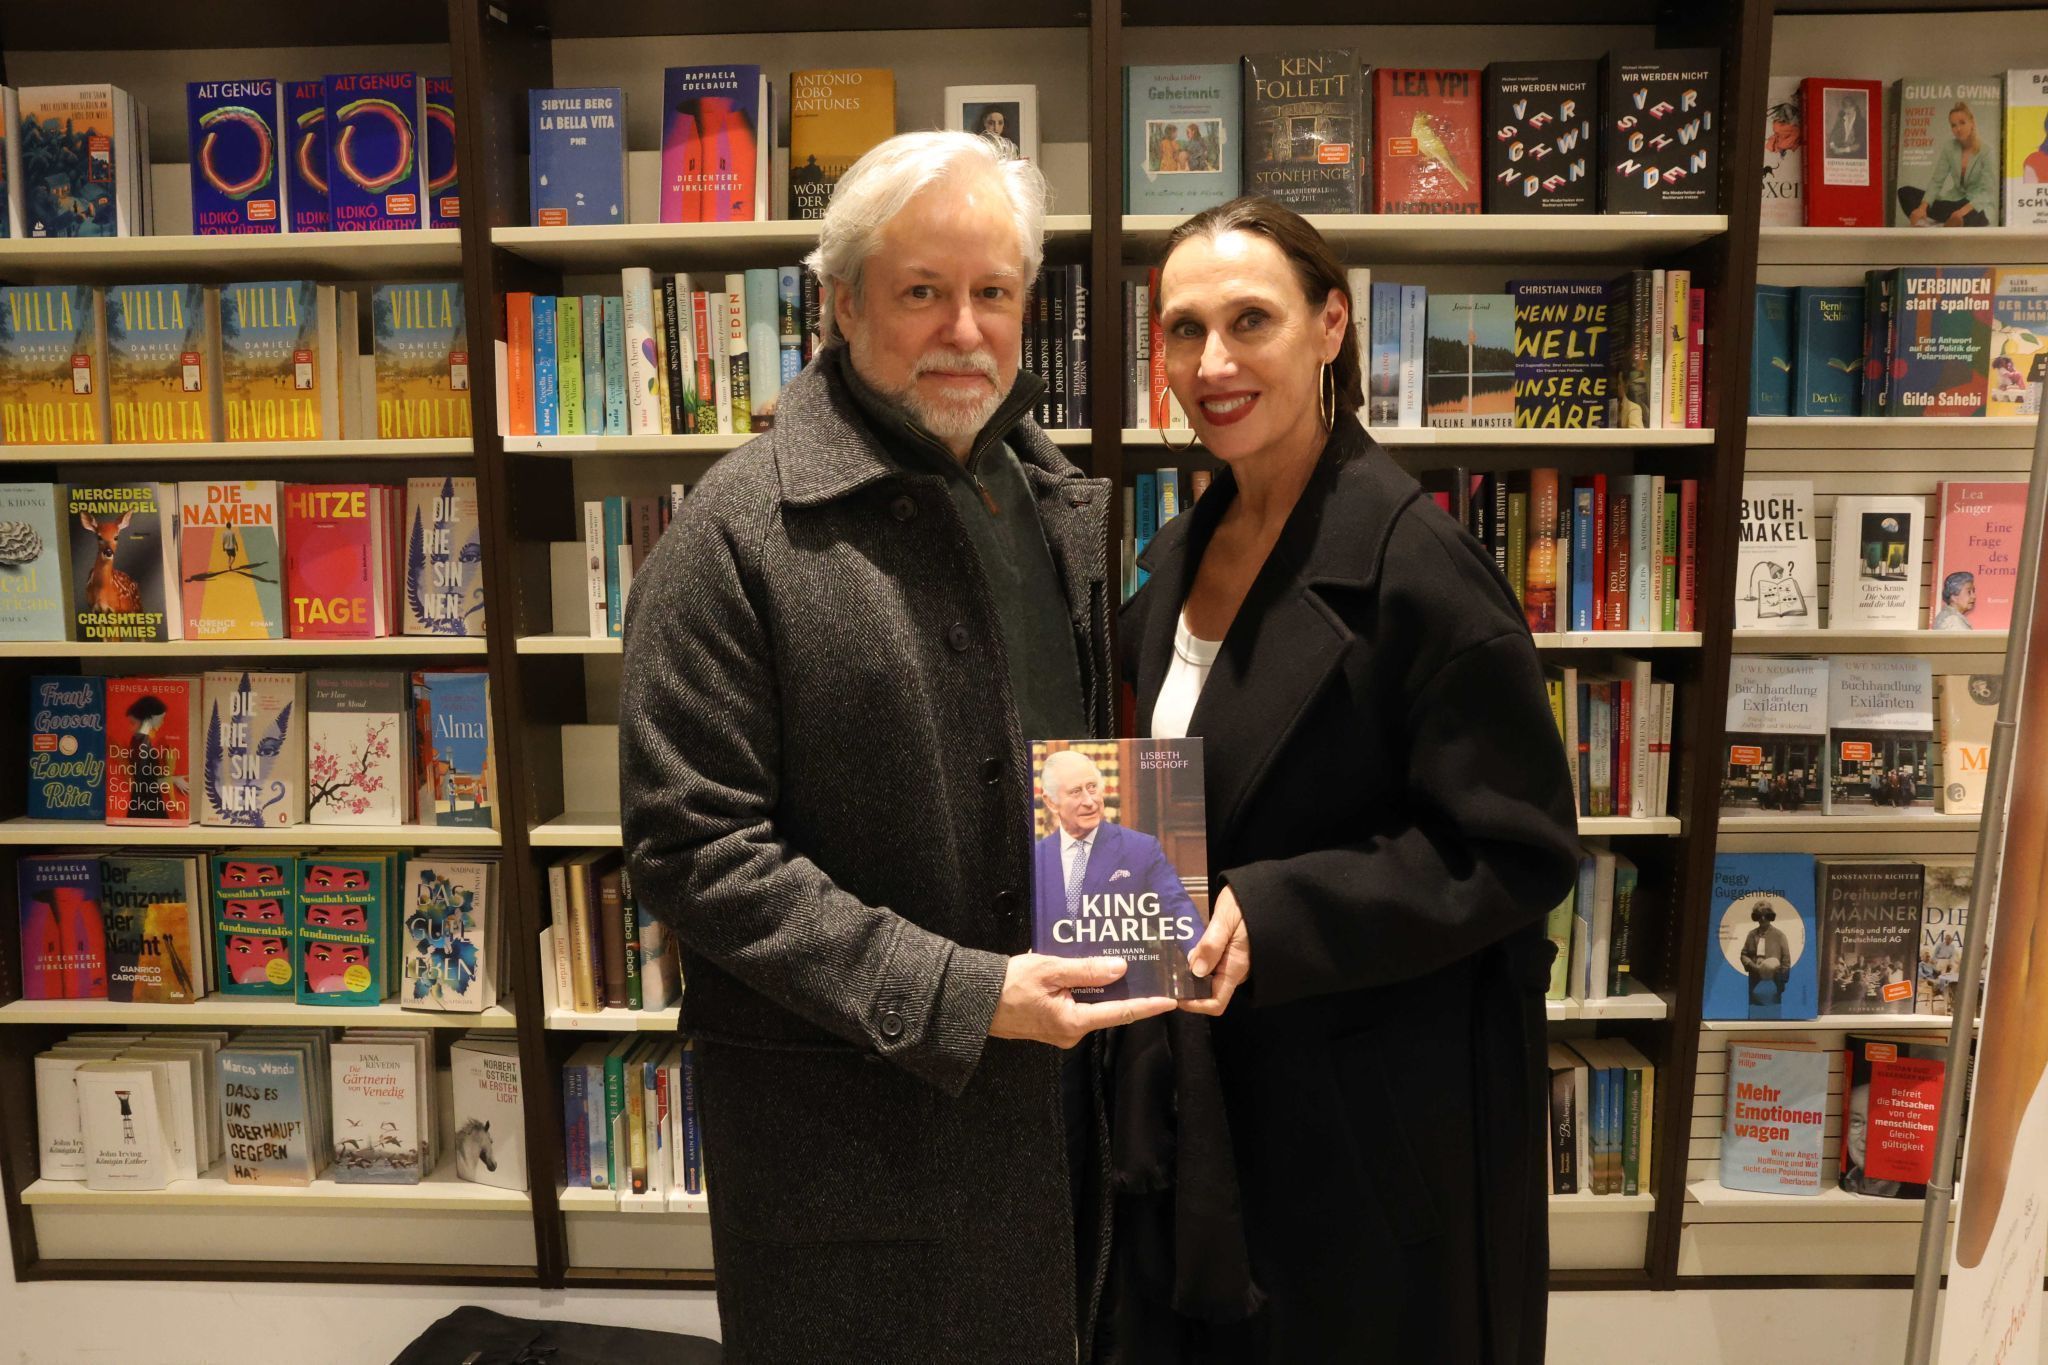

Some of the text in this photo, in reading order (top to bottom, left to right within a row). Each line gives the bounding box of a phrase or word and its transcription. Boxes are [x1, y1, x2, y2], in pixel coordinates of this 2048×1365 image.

[1281, 57, 1323, 76] KEN
[685, 71, 736, 81] RAPHAELA
[795, 72, 862, 87] ANTÓNIO
[198, 81, 272, 99] ALT GENUG
[682, 82, 739, 91] EDELBAUER
[1256, 75, 1350, 100] FOLLETT
[1392, 72, 1469, 98] LEA YPI
[1501, 83, 1587, 93] WIR WERDEN NICHT
[1904, 85, 2001, 100] GIULIA GWINN
[796, 87, 832, 99] LOBO
[541, 98, 613, 110] SIBYLLE BERG
[795, 98, 860, 111] ANTUNES
[1904, 107, 1935, 116] WRITE
[540, 115, 615, 130] LA BELLA VITA
[1904, 117, 1931, 126] YOUR
[1904, 128, 1927, 137] OWN
[1903, 138, 1935, 148] STORY
[1256, 169, 1351, 183] STONEHENGE
[672, 184, 743, 193] WIRKLICHKEIT
[336, 204, 378, 219] ILDIKÓ
[1519, 286, 1602, 296] CHRISTIAN LINKER
[1906, 278, 1991, 295] VERBINDEN
[10, 291, 73, 332] VILLA
[122, 290, 184, 330] VILLA
[236, 287, 297, 328] VILLA
[1072, 284, 1090, 341] Penny
[1905, 296, 1990, 314] statt spalten
[730, 293, 742, 339] EDEN
[1515, 304, 1608, 322] WENN DIE
[1514, 326, 1608, 360] WELT
[1919, 336, 1973, 344] Eine Antwort
[1909, 345, 1924, 353] auf
[1938, 344, 1964, 352] Politik
[1965, 344, 1981, 352] der
[1055, 337, 1065, 393] JOHN BOYNE
[1917, 353, 1973, 362] Polarisierung
[1073, 361, 1081, 397] THOMAS
[1080, 360, 1088, 395] BREZINA
[1515, 377, 1608, 399] UNSERE
[1903, 391, 1982, 407] Gilda Sahebi
[115, 400, 206, 440] RIVOLTA
[228, 398, 317, 440] RIVOLTA
[1515, 399, 1608, 429] WÄRE
[4, 402, 96, 442] RIVOLTA
[1432, 418, 1513, 428] KLEINE MONSTER
[72, 487, 154, 501] MERCEDES
[208, 485, 242, 504] DIE
[1962, 488, 1985, 499] Lea
[70, 501, 158, 514] SPANNAGEL
[287, 491, 367, 519] HITZE
[1740, 498, 1804, 521] BUCH-
[1954, 502, 1994, 515] Singer
[183, 503, 273, 525] NAMEN
[1739, 520, 1809, 543] MAKEL
[1986, 522, 2014, 533] Eine
[1970, 535, 2004, 548] Frage
[1990, 552, 2010, 562] des
[1619, 551, 1627, 592] PICOULT
[293, 597, 367, 624] TAGE
[78, 612, 164, 626] CRASHTEST
[190, 619, 236, 628] FLORENCE
[86, 626, 157, 638] DUMMIES
[198, 626, 229, 635] KNAPP
[41, 683, 94, 707] Frank
[1734, 683, 1817, 697] Buchhandlung
[231, 691, 257, 718] DIE
[1742, 699, 1808, 713] Exilanten
[35, 710, 103, 732] Goosen
[435, 714, 486, 740] Alma
[221, 722, 248, 749] RIE
[109, 744, 181, 760] Der Sohn
[1140, 751, 1180, 761] LISBETH
[30, 752, 105, 787] Lovely
[109, 763, 171, 776] und das
[232, 755, 260, 780] SIN
[1140, 760, 1189, 770] BISCHOFF
[109, 778, 171, 794] Schnee
[43, 781, 93, 808] Rita
[221, 785, 257, 812] NEN
[109, 796, 186, 813] flöckchen
[1714, 872, 1750, 886] Peggy
[1831, 873, 1882, 881] KONSTANTIN
[1715, 886, 1786, 901] Guggenheim
[1832, 887, 1919, 901] Dreihundert
[1082, 892, 1161, 918] KING
[1830, 901, 1918, 921] MÄNNER
[218, 921, 293, 937] fundamentalös
[1052, 916, 1195, 944] CHARLES
[1834, 926, 1911, 937] Aufstieg und Fall der
[623, 907, 635, 978] Halbe Leben
[1842, 935, 1902, 944] Deutschland AG
[1103, 947, 1145, 956] KEIN MANN
[120, 965, 161, 975] GIANRICO
[111, 973, 162, 984] CAROFIGLIO
[1070, 986, 1104, 995] Amalthea
[222, 1058, 295, 1076] Marco Wanda
[349, 1065, 361, 1073] Die
[483, 1059, 517, 1072] NORBERT
[343, 1074, 397, 1085] Gärtnerin
[486, 1070, 518, 1083] GSTREIN
[226, 1083, 279, 1101] DASS ES
[362, 1086, 405, 1099] Venedig
[496, 1092, 518, 1104] LICHT
[1737, 1082, 1781, 1103] Mehr
[1891, 1088, 1923, 1099] Befreit
[226, 1102, 252, 1120] UNS
[1877, 1097, 1936, 1110] die Tatsachen
[1735, 1103, 1823, 1125] Emotionen
[1889, 1109, 1923, 1120] von der
[227, 1120, 301, 1142] ÜBERHAUPT
[1734, 1122, 1790, 1143] wagen
[1874, 1118, 1934, 1132] menschlichen
[1889, 1130, 1921, 1140] Gleich-
[231, 1143, 288, 1162] GEGEBEN
[1881, 1139, 1925, 1153] gültigkeit
[1743, 1165, 1818, 1178] nicht dem Populismus
